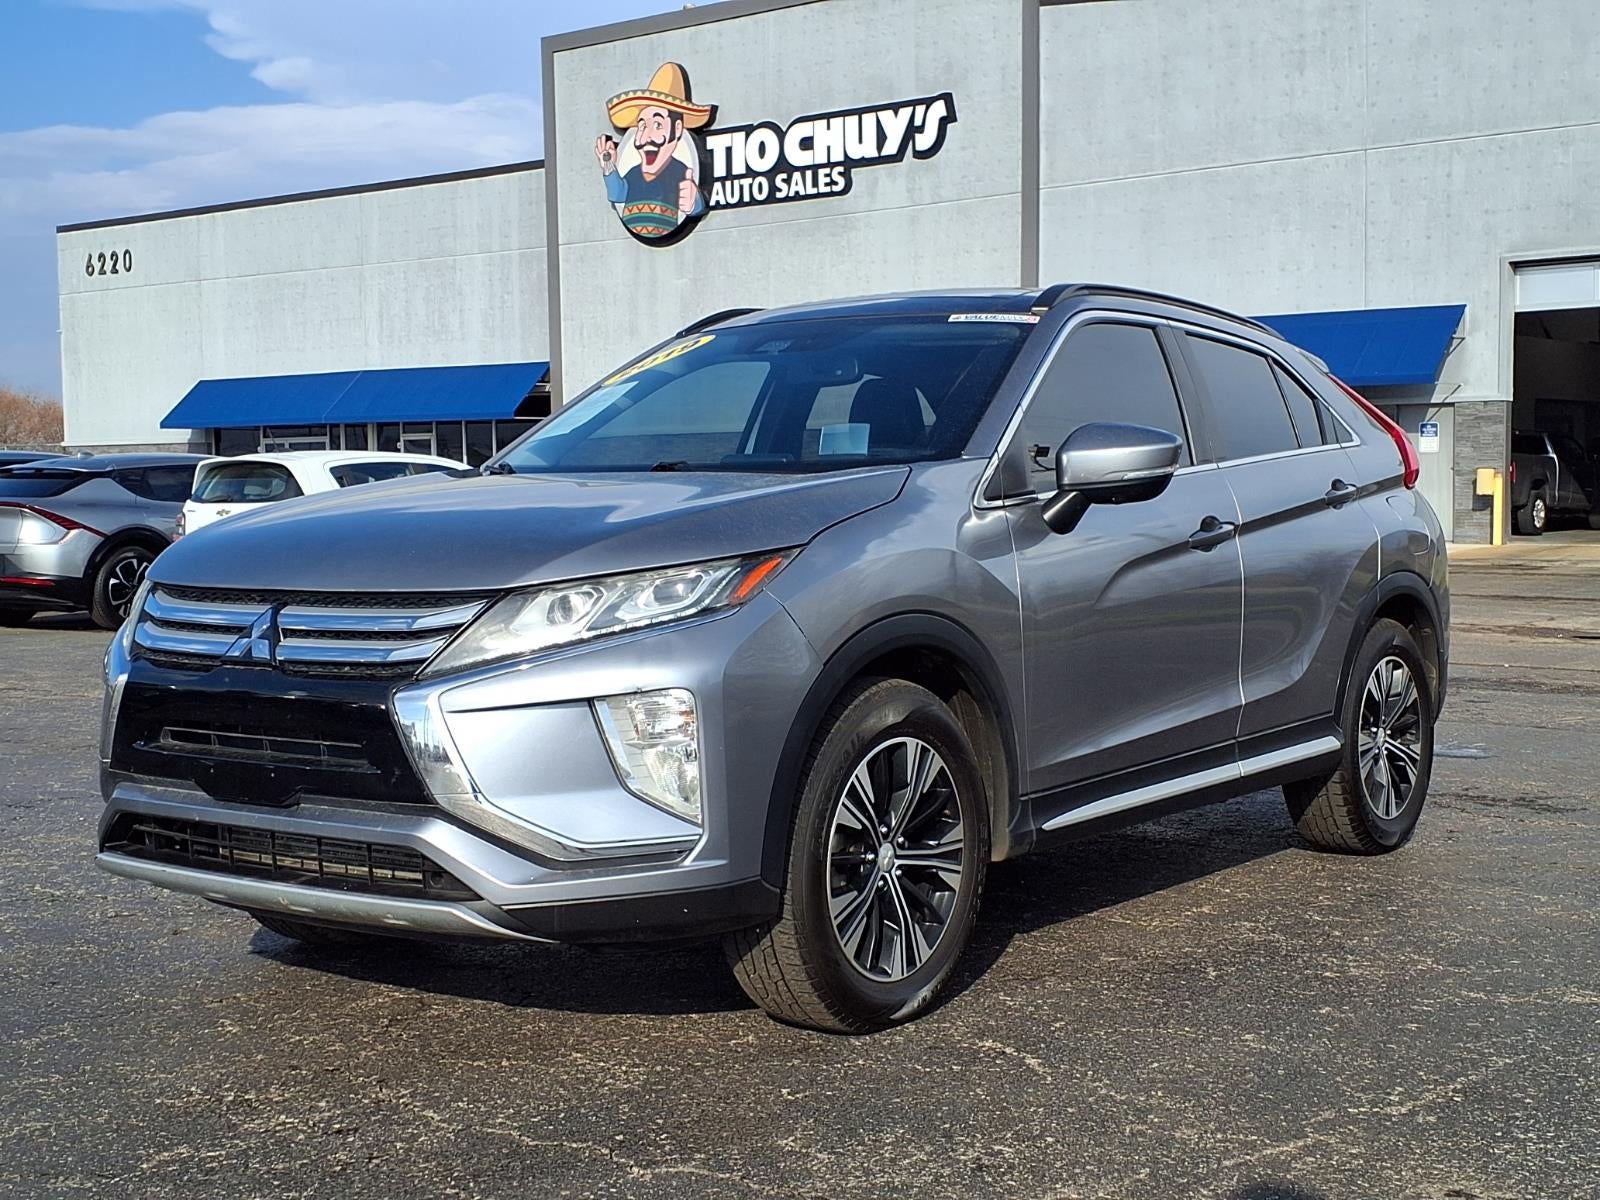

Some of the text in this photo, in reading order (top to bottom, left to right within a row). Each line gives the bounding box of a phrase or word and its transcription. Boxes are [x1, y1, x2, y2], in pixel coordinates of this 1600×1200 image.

[706, 127, 780, 178] TIO
[709, 166, 845, 206] AUTO SALES
[85, 249, 132, 277] 6220
